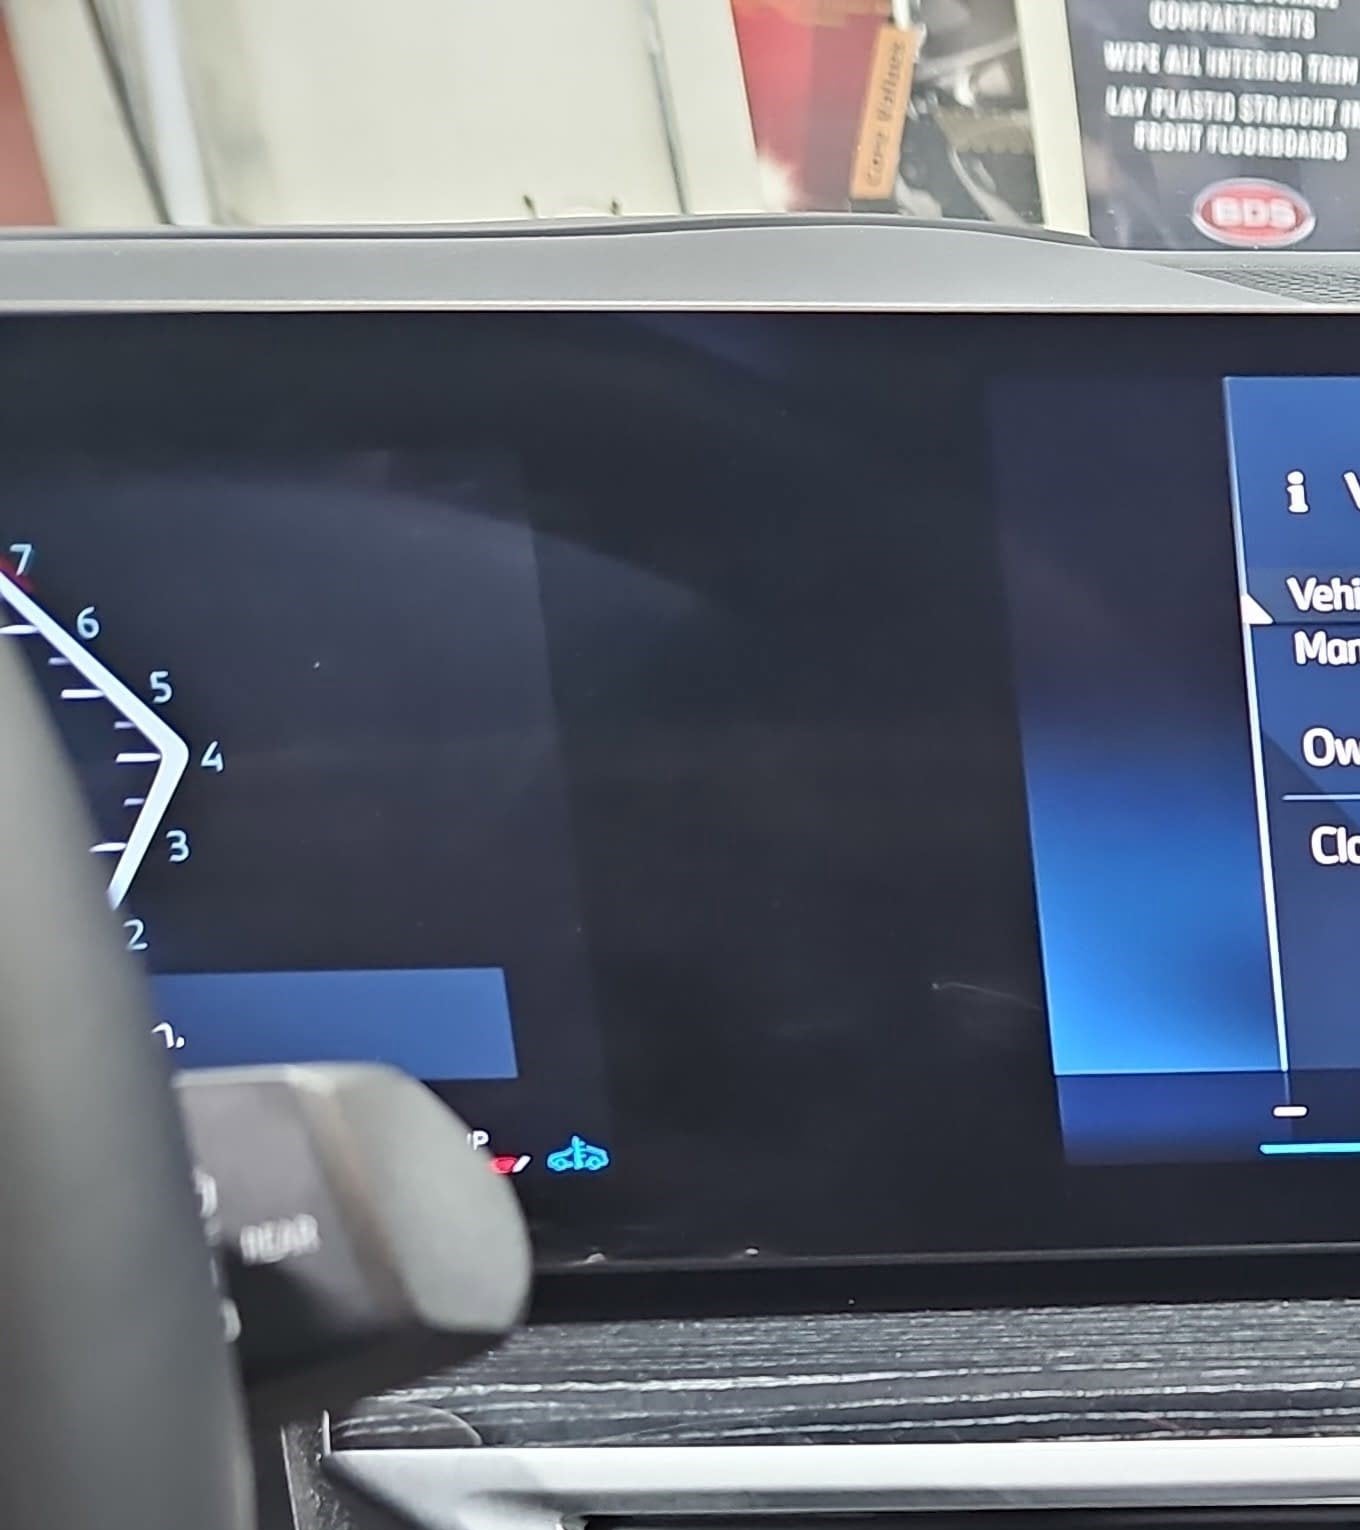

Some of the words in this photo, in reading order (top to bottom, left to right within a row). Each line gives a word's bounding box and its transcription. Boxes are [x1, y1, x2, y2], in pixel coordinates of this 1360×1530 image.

[1149, 1, 1317, 39] COMPARTMENTS
[1103, 41, 1161, 74] WIPE
[1163, 44, 1202, 77] ALL
[1205, 48, 1303, 82] INTERIOR
[1307, 53, 1359, 86] TRIM
[1105, 86, 1147, 117] LAY
[1151, 88, 1236, 122] PLASTIC
[1239, 93, 1338, 128] STRAIGHT
[1133, 121, 1204, 153] FRONT
[1206, 124, 1348, 161] FLOORBOARDS
[10, 543, 33, 574] 7
[77, 606, 99, 639] 6
[150, 671, 172, 703] 5
[201, 741, 223, 772] 4
[166, 830, 190, 862] 3
[124, 919, 148, 950] 2
